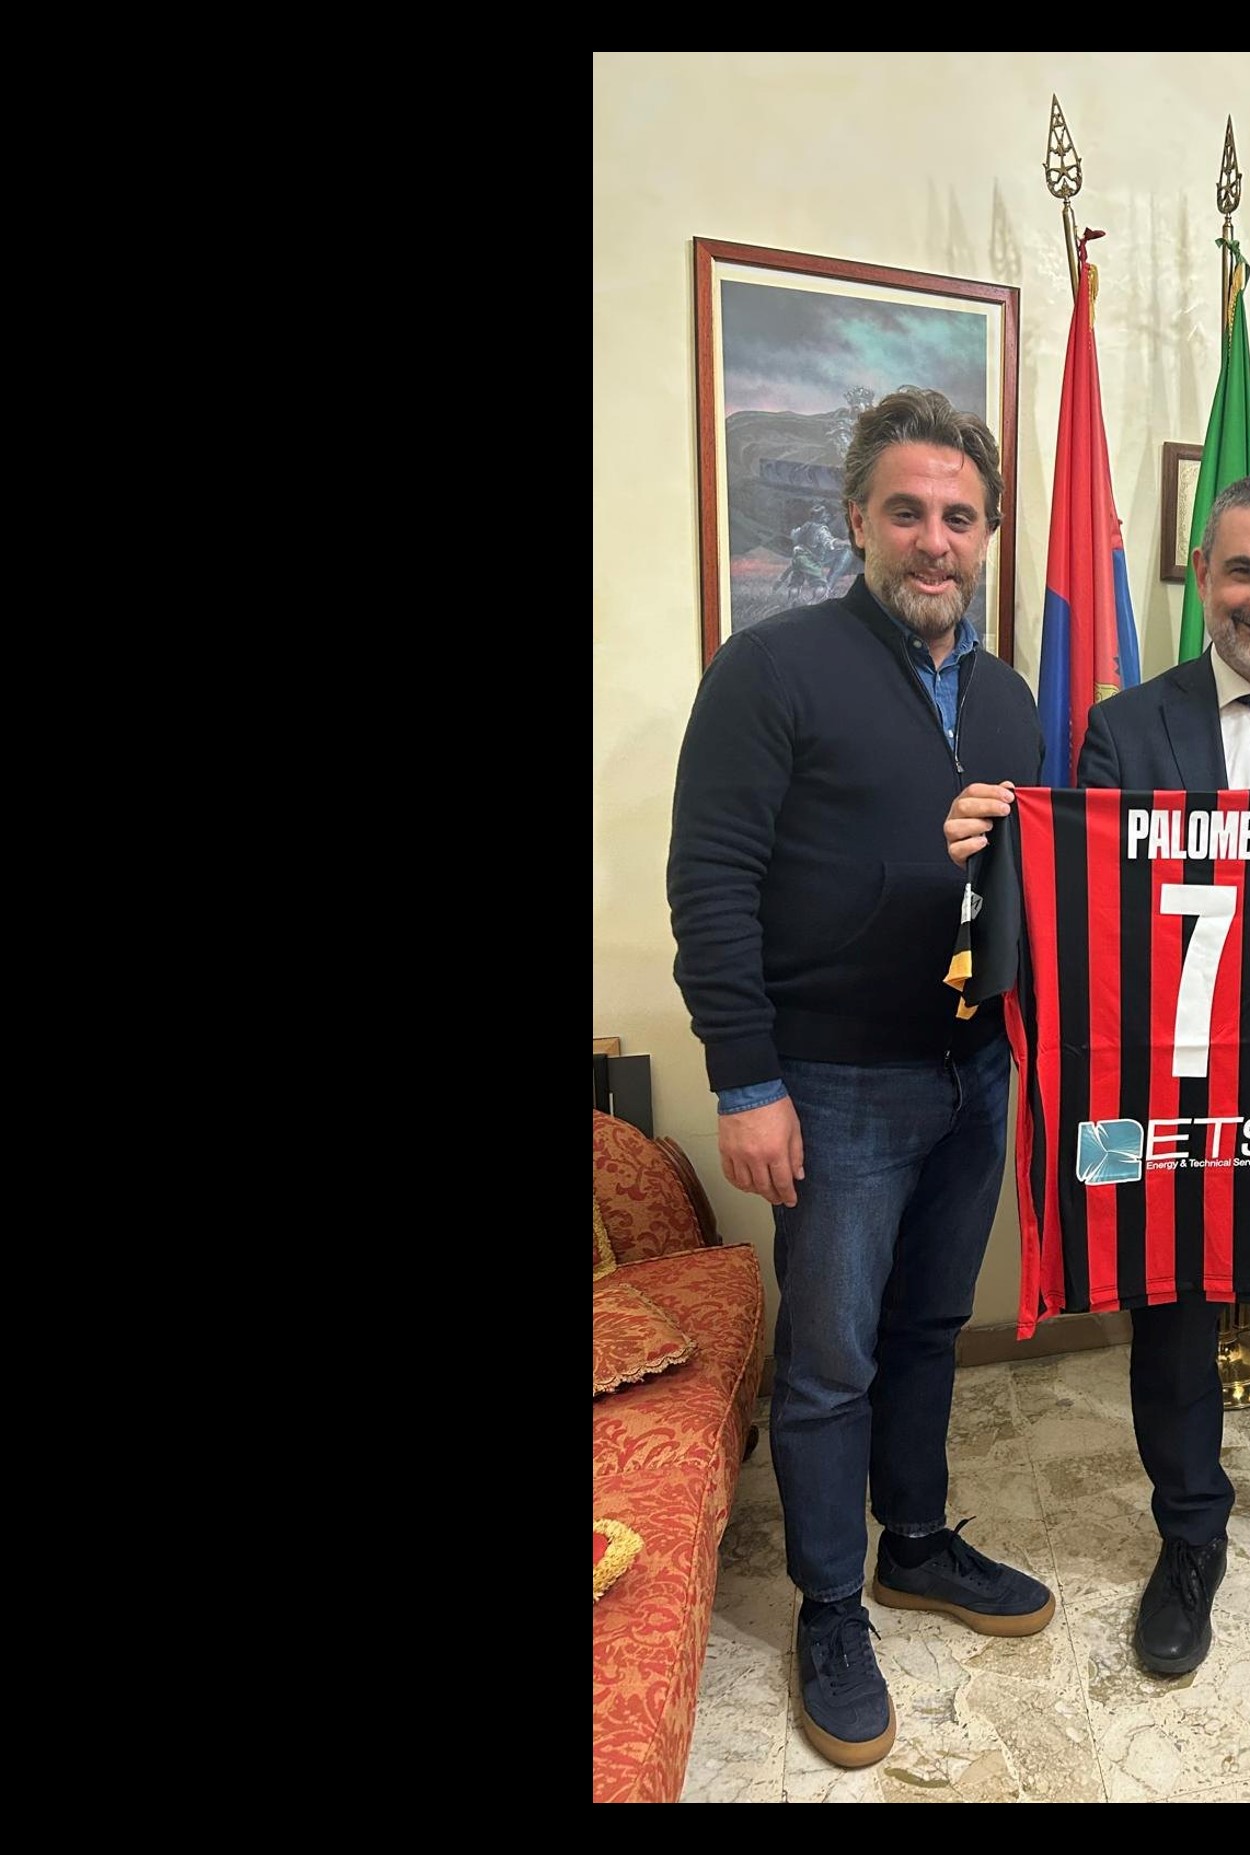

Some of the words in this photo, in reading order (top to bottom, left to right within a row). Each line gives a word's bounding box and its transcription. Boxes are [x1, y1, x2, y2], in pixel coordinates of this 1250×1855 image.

[1160, 883, 1238, 1078] 7
[1146, 1160, 1178, 1170] Energy
[1179, 1159, 1187, 1168] &
[1189, 1158, 1231, 1168] Technical
